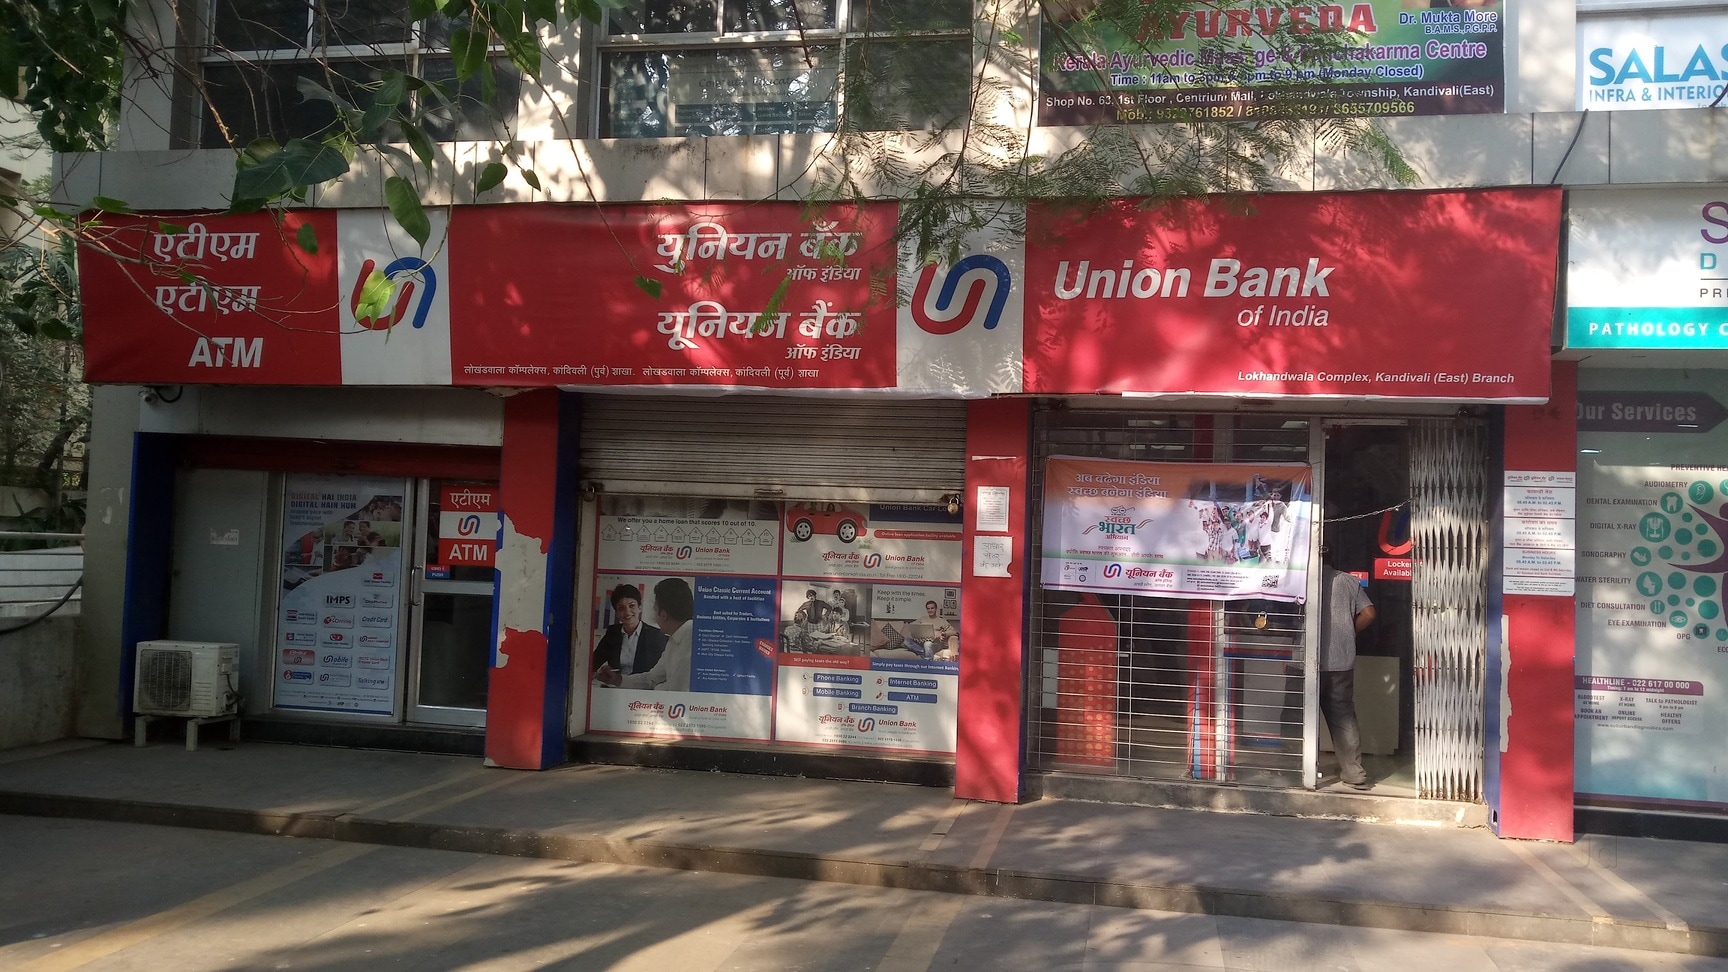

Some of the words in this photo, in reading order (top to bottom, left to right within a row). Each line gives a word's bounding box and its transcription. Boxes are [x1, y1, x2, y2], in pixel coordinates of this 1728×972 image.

[1136, 4, 1377, 40] AYURVEDA
[1399, 12, 1417, 25] Dr.
[1421, 12, 1460, 24] Mukta
[1464, 10, 1498, 22] More
[1053, 52, 1107, 72] Kerala
[1110, 49, 1195, 73] Ayurvedic
[1200, 47, 1277, 68] Massge
[1425, 40, 1487, 59] Centre
[1111, 74, 1139, 86] Time
[1150, 74, 1179, 85] 11am
[1184, 72, 1196, 83] to
[1375, 64, 1424, 79] Closed)
[1046, 96, 1074, 108] Shop
[1078, 95, 1095, 106] No.
[1118, 93, 1134, 105] 1st
[1138, 93, 1165, 104] Floor
[1403, 84, 1494, 97] Kandivali(East)
[1590, 89, 1636, 102] INFRA
[1641, 87, 1652, 102] &
[1658, 84, 1728, 101] INTERIO
[154, 223, 260, 262] एटीएम
[654, 221, 792, 273] युनियन
[786, 264, 818, 280] ऑफ
[822, 264, 862, 282] इंडिया
[1054, 260, 1191, 299] Union
[1204, 258, 1335, 298] Bank
[1237, 305, 1263, 327] of
[1269, 305, 1329, 327] India
[657, 300, 791, 350] यूनियन
[799, 299, 862, 339] बैंक
[1589, 322, 1709, 336] PATHOLOGY
[188, 337, 264, 368] ATM
[785, 344, 818, 360] ऑफ
[821, 344, 862, 361] इंडिया
[1238, 371, 1314, 382] Lokhandwala
[1317, 372, 1372, 384] Complex,
[1375, 372, 1431, 383] Kandivali
[1433, 372, 1469, 385] (East)
[1472, 373, 1515, 384] Branch
[1611, 402, 1697, 421] Services
[1075, 473, 1093, 482] अब
[1129, 472, 1161, 486] इंडिया
[449, 488, 491, 509] एटीएम
[1067, 486, 1099, 496] स्वच्छ
[1101, 485, 1134, 498] बनेगा
[1136, 486, 1168, 499] इंडिया
[1612, 498, 1658, 506] EXAMINATION
[1104, 515, 1133, 523] स्वच्छ
[1589, 522, 1615, 530] DIGITAL
[1098, 521, 1136, 535] भारत
[448, 543, 487, 561] ATM
[885, 554, 905, 562] Union
[906, 555, 925, 563] Bank
[1581, 551, 1627, 559] SONOGRAPHY
[1125, 567, 1158, 580] यूनियन
[1158, 568, 1175, 578] बैंक
[713, 586, 731, 594] Classic
[877, 589, 890, 597] Keep
[326, 595, 350, 605] IMPS
[1596, 602, 1646, 610] CONSULTATION
[1621, 620, 1667, 628] EXAMINATION
[836, 675, 859, 683] Banking
[913, 680, 936, 688] Banking
[1582, 677, 1625, 686] HEALTHLINE
[1675, 681, 1690, 689] 000
[836, 690, 859, 698] Banking
[872, 705, 896, 713] Banking
